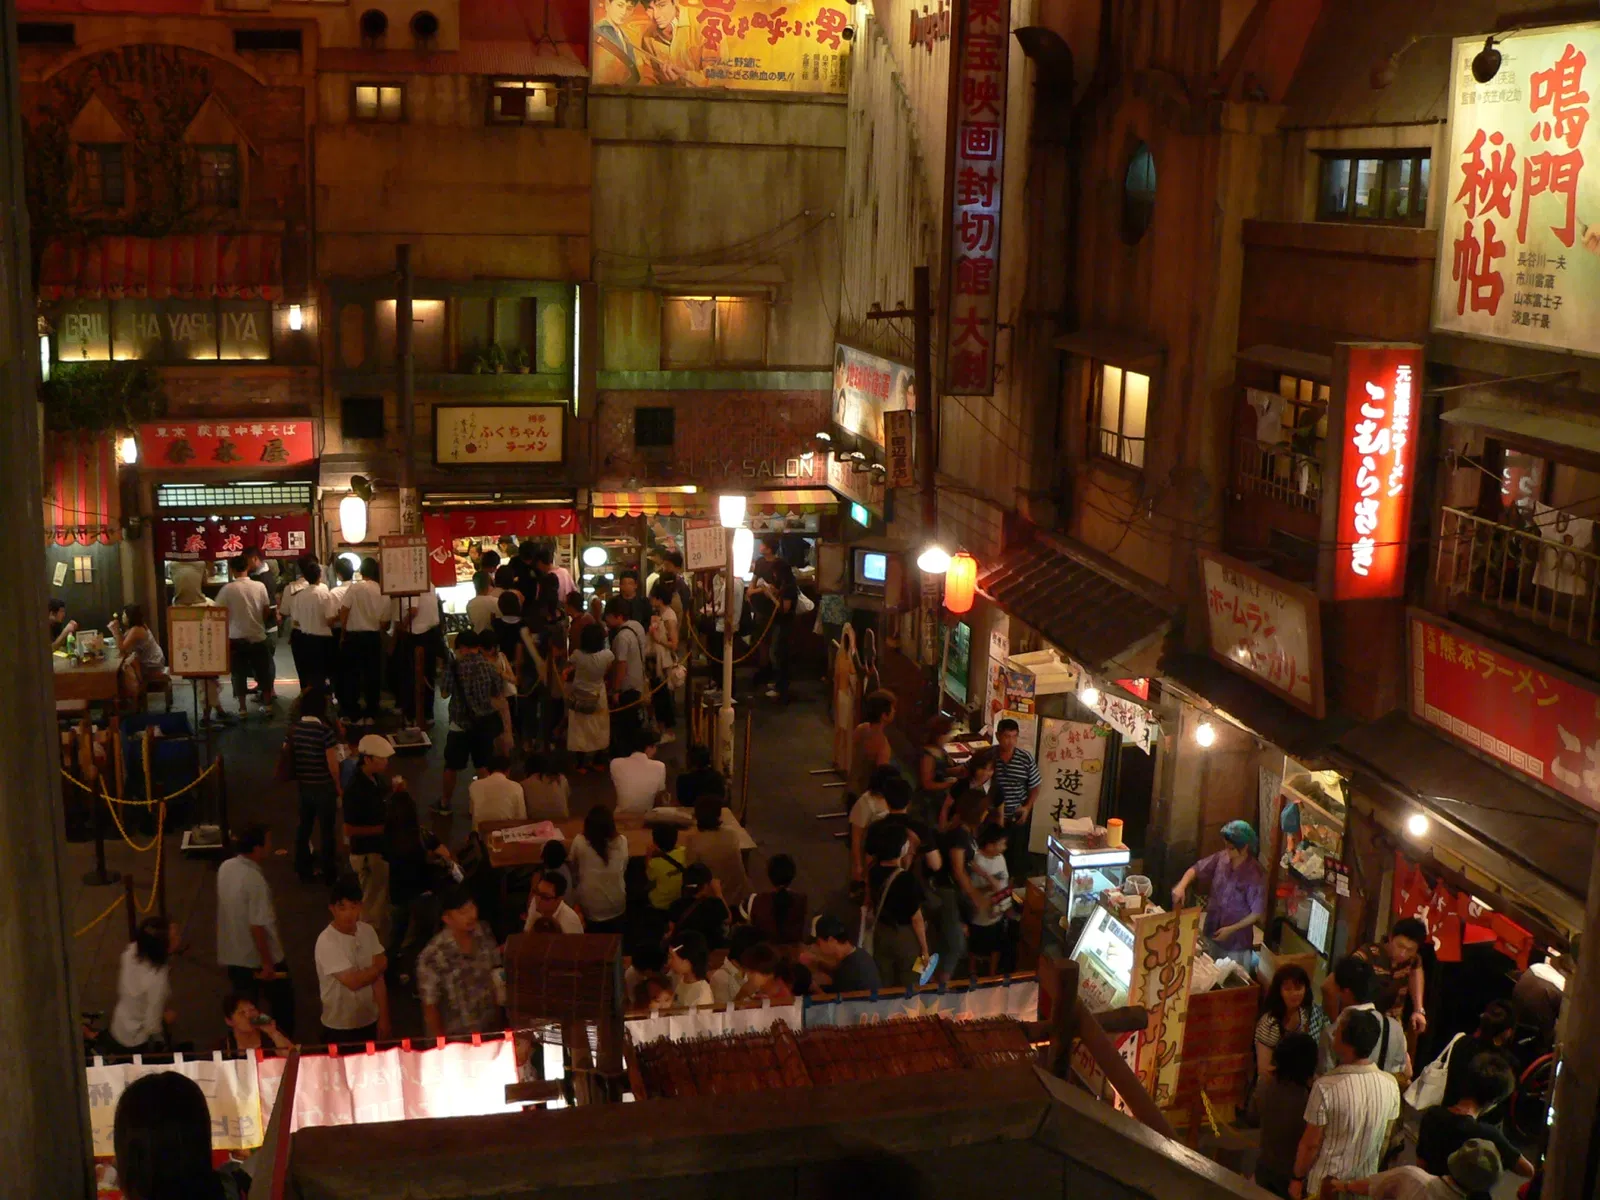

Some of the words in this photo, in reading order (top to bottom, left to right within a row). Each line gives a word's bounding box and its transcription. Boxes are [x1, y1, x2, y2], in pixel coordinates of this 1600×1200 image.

[1516, 43, 1590, 248] 鳴門
[1452, 128, 1517, 317] 秘帖
[1517, 251, 1567, 270] 長谷川一夫
[1513, 291, 1563, 311] 山本富士子
[480, 425, 550, 438] ふくちゃん
[506, 440, 547, 452] ラーメン
[742, 458, 814, 479] SALON
[1352, 380, 1385, 576] こむらさき
[465, 514, 572, 533] ラーメン
[1209, 584, 1277, 639] ホームラン
[1439, 632, 1560, 706] 熊本ラーメン
[1067, 727, 1096, 744] 射的
